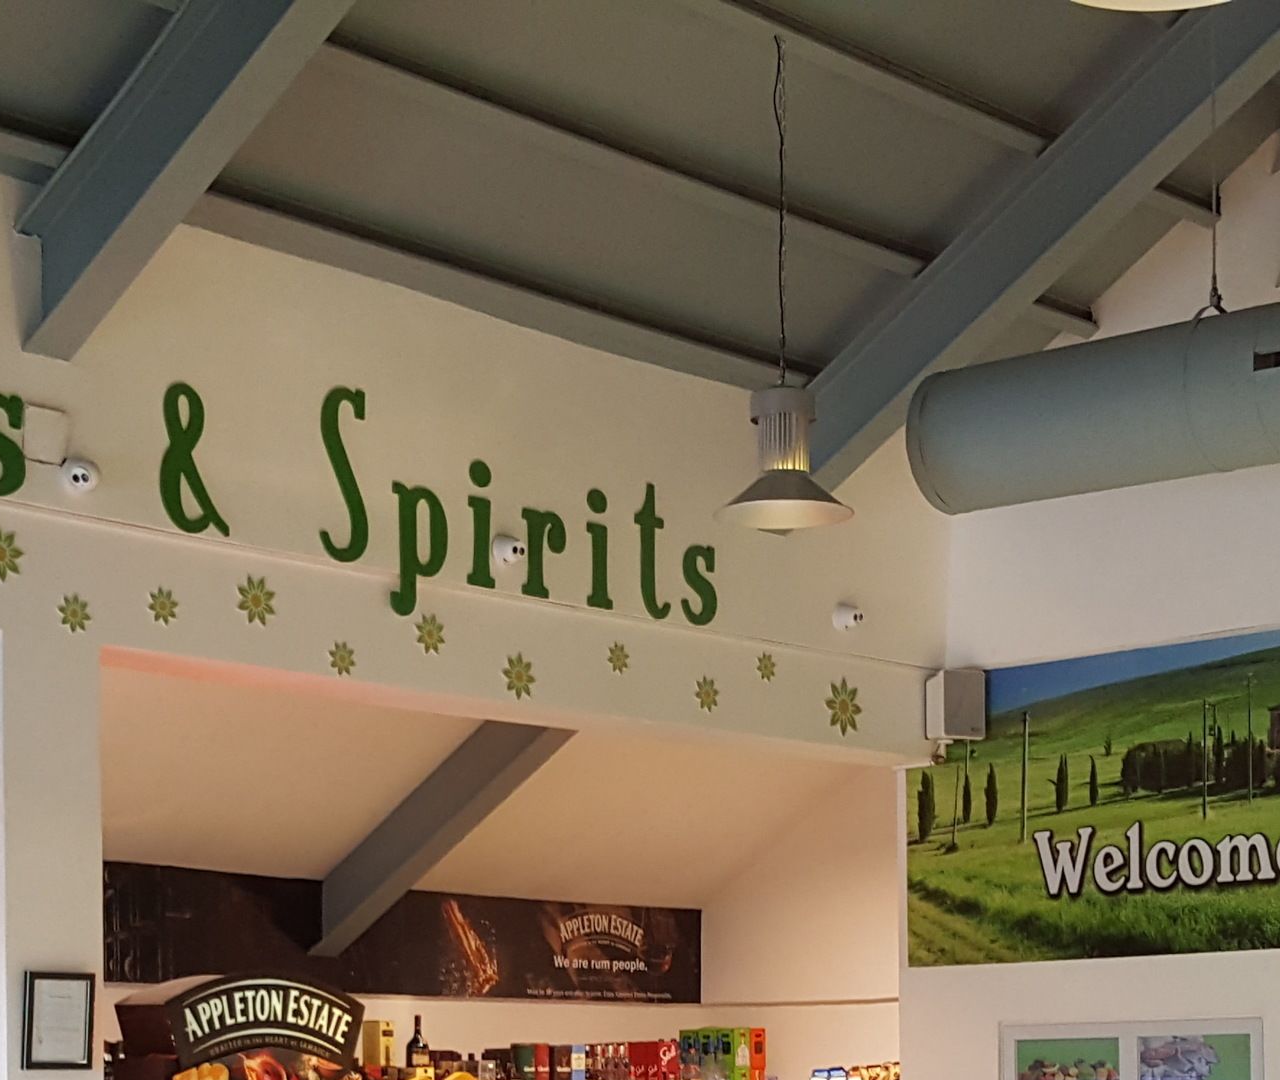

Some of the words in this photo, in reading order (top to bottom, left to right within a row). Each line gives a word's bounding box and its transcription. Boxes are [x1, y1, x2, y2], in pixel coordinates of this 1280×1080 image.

[157, 381, 231, 538] &
[320, 386, 718, 627] Spirits
[559, 913, 610, 942] APPLETON
[609, 914, 645, 947] ESTATE
[553, 955, 570, 968] We
[571, 958, 588, 969] are
[590, 959, 611, 970] rum
[612, 957, 648, 973] people.
[184, 989, 284, 1043] APPLETON
[286, 988, 353, 1045] ESTATE
